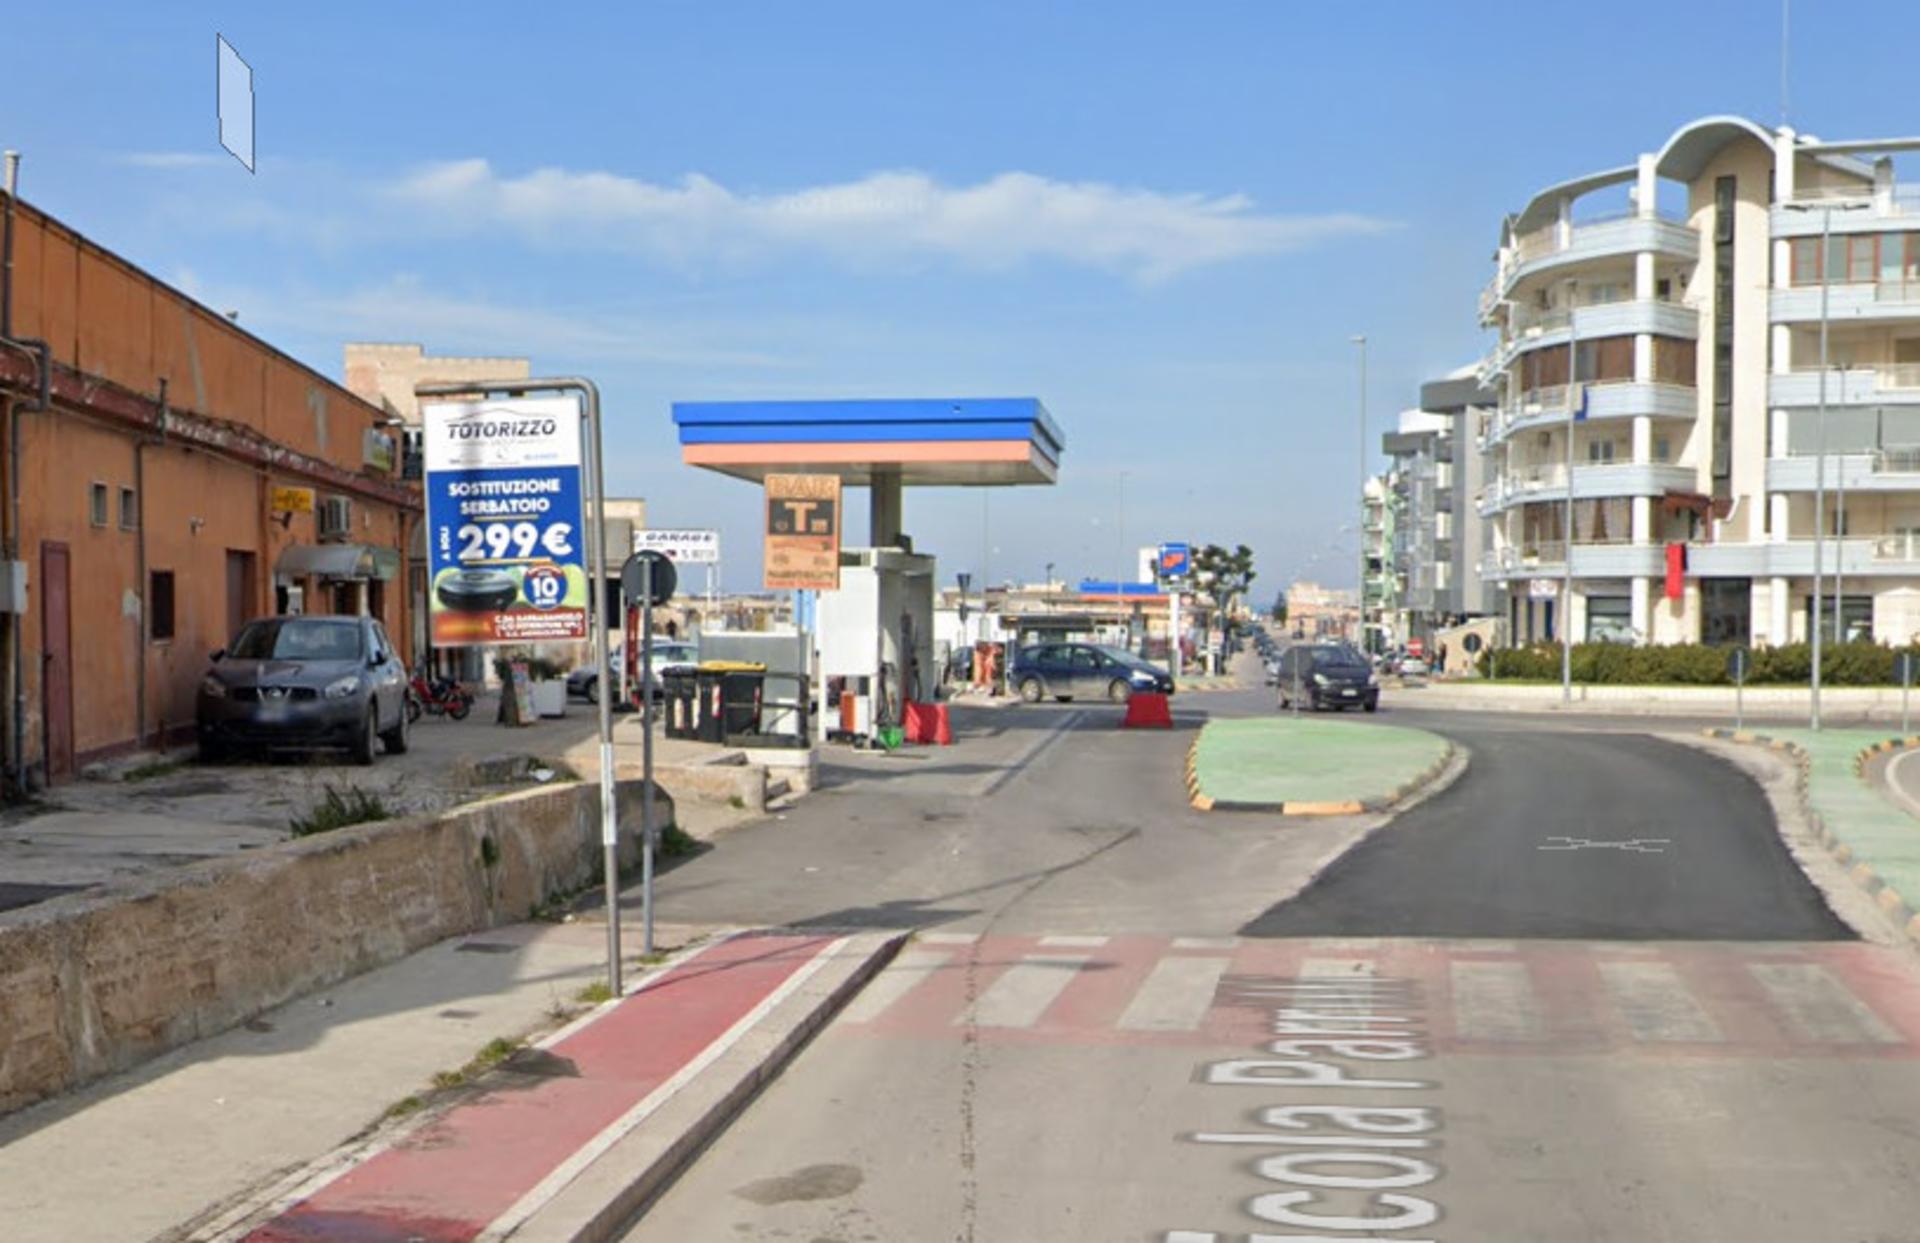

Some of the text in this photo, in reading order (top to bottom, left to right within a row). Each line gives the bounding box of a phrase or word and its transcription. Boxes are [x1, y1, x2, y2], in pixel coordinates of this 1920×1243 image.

[447, 419, 557, 440] TOTORIZZO
[448, 478, 561, 497] SOSTITUZIONE
[460, 497, 550, 515] SERBATOIO
[784, 501, 818, 532] T
[457, 522, 573, 560] 299€
[531, 577, 560, 598] 10
